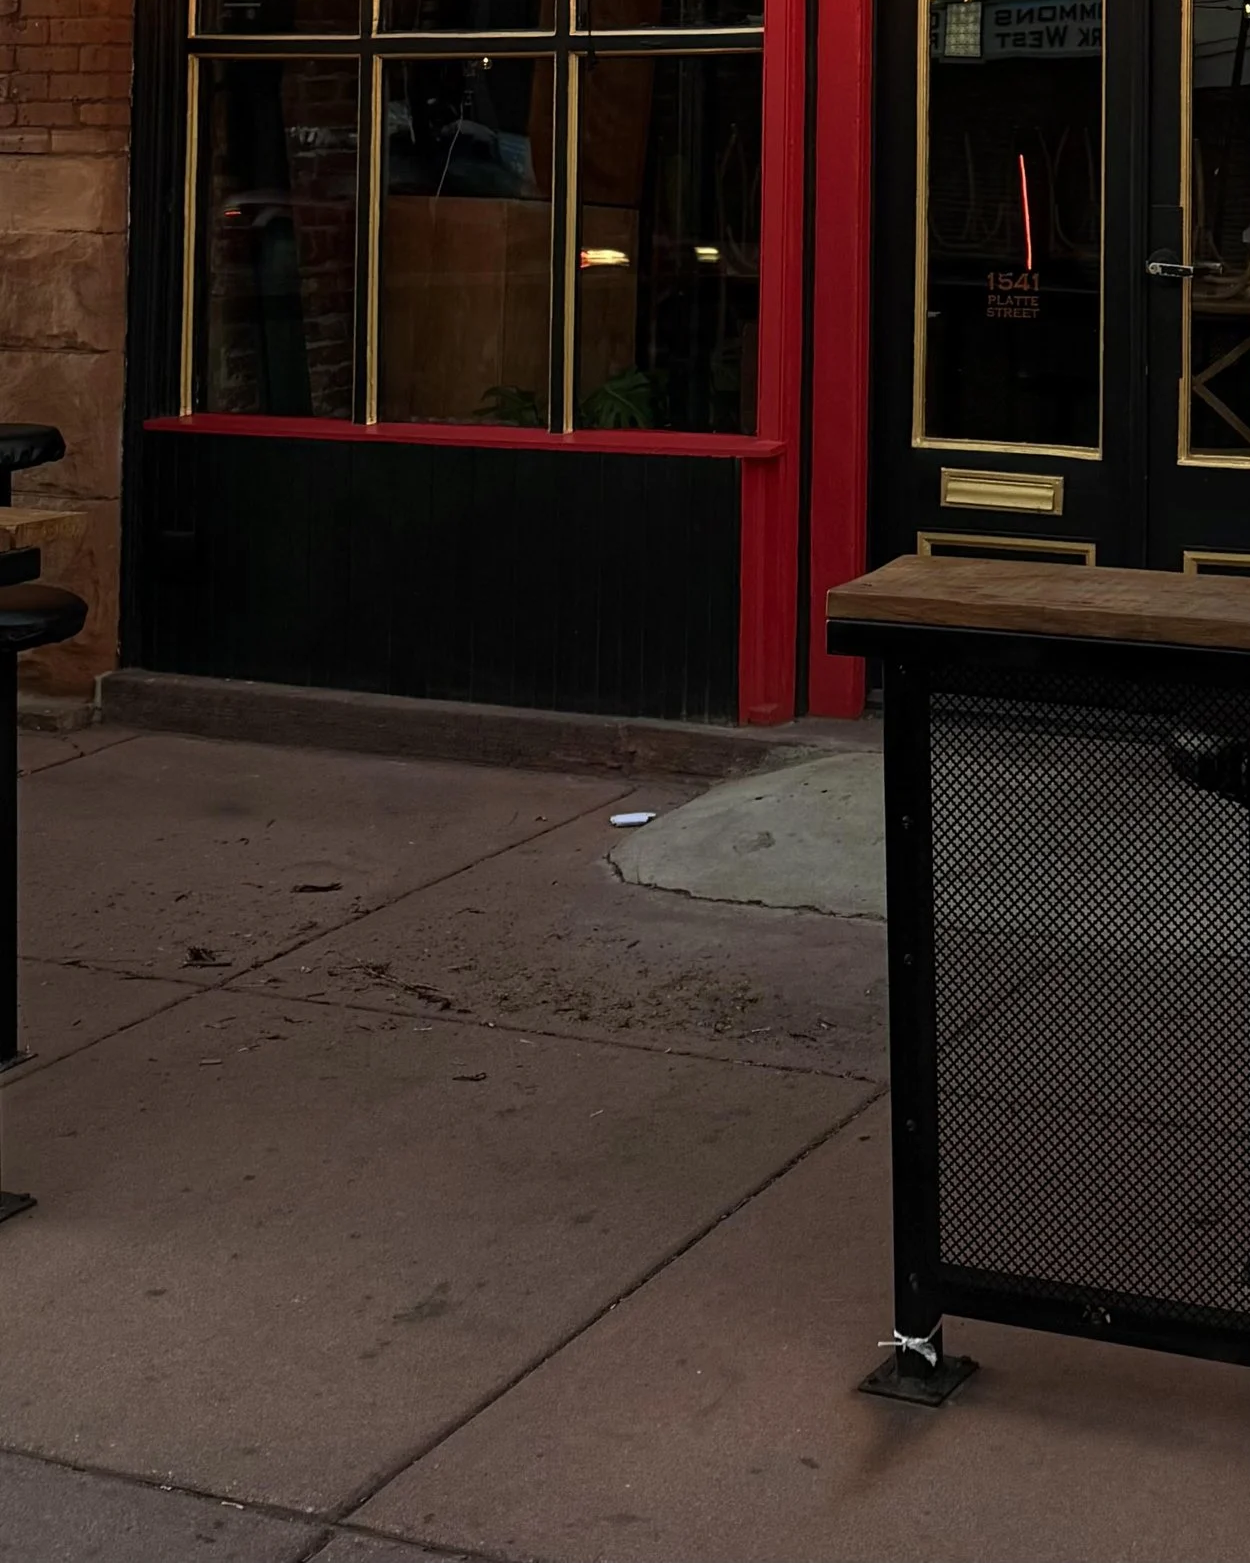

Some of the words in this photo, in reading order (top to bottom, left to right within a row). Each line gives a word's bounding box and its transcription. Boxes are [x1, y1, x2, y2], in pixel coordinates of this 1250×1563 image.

[986, 269, 1041, 292] 1541
[986, 294, 1041, 307] PLATTE
[986, 307, 1041, 320] STREET
